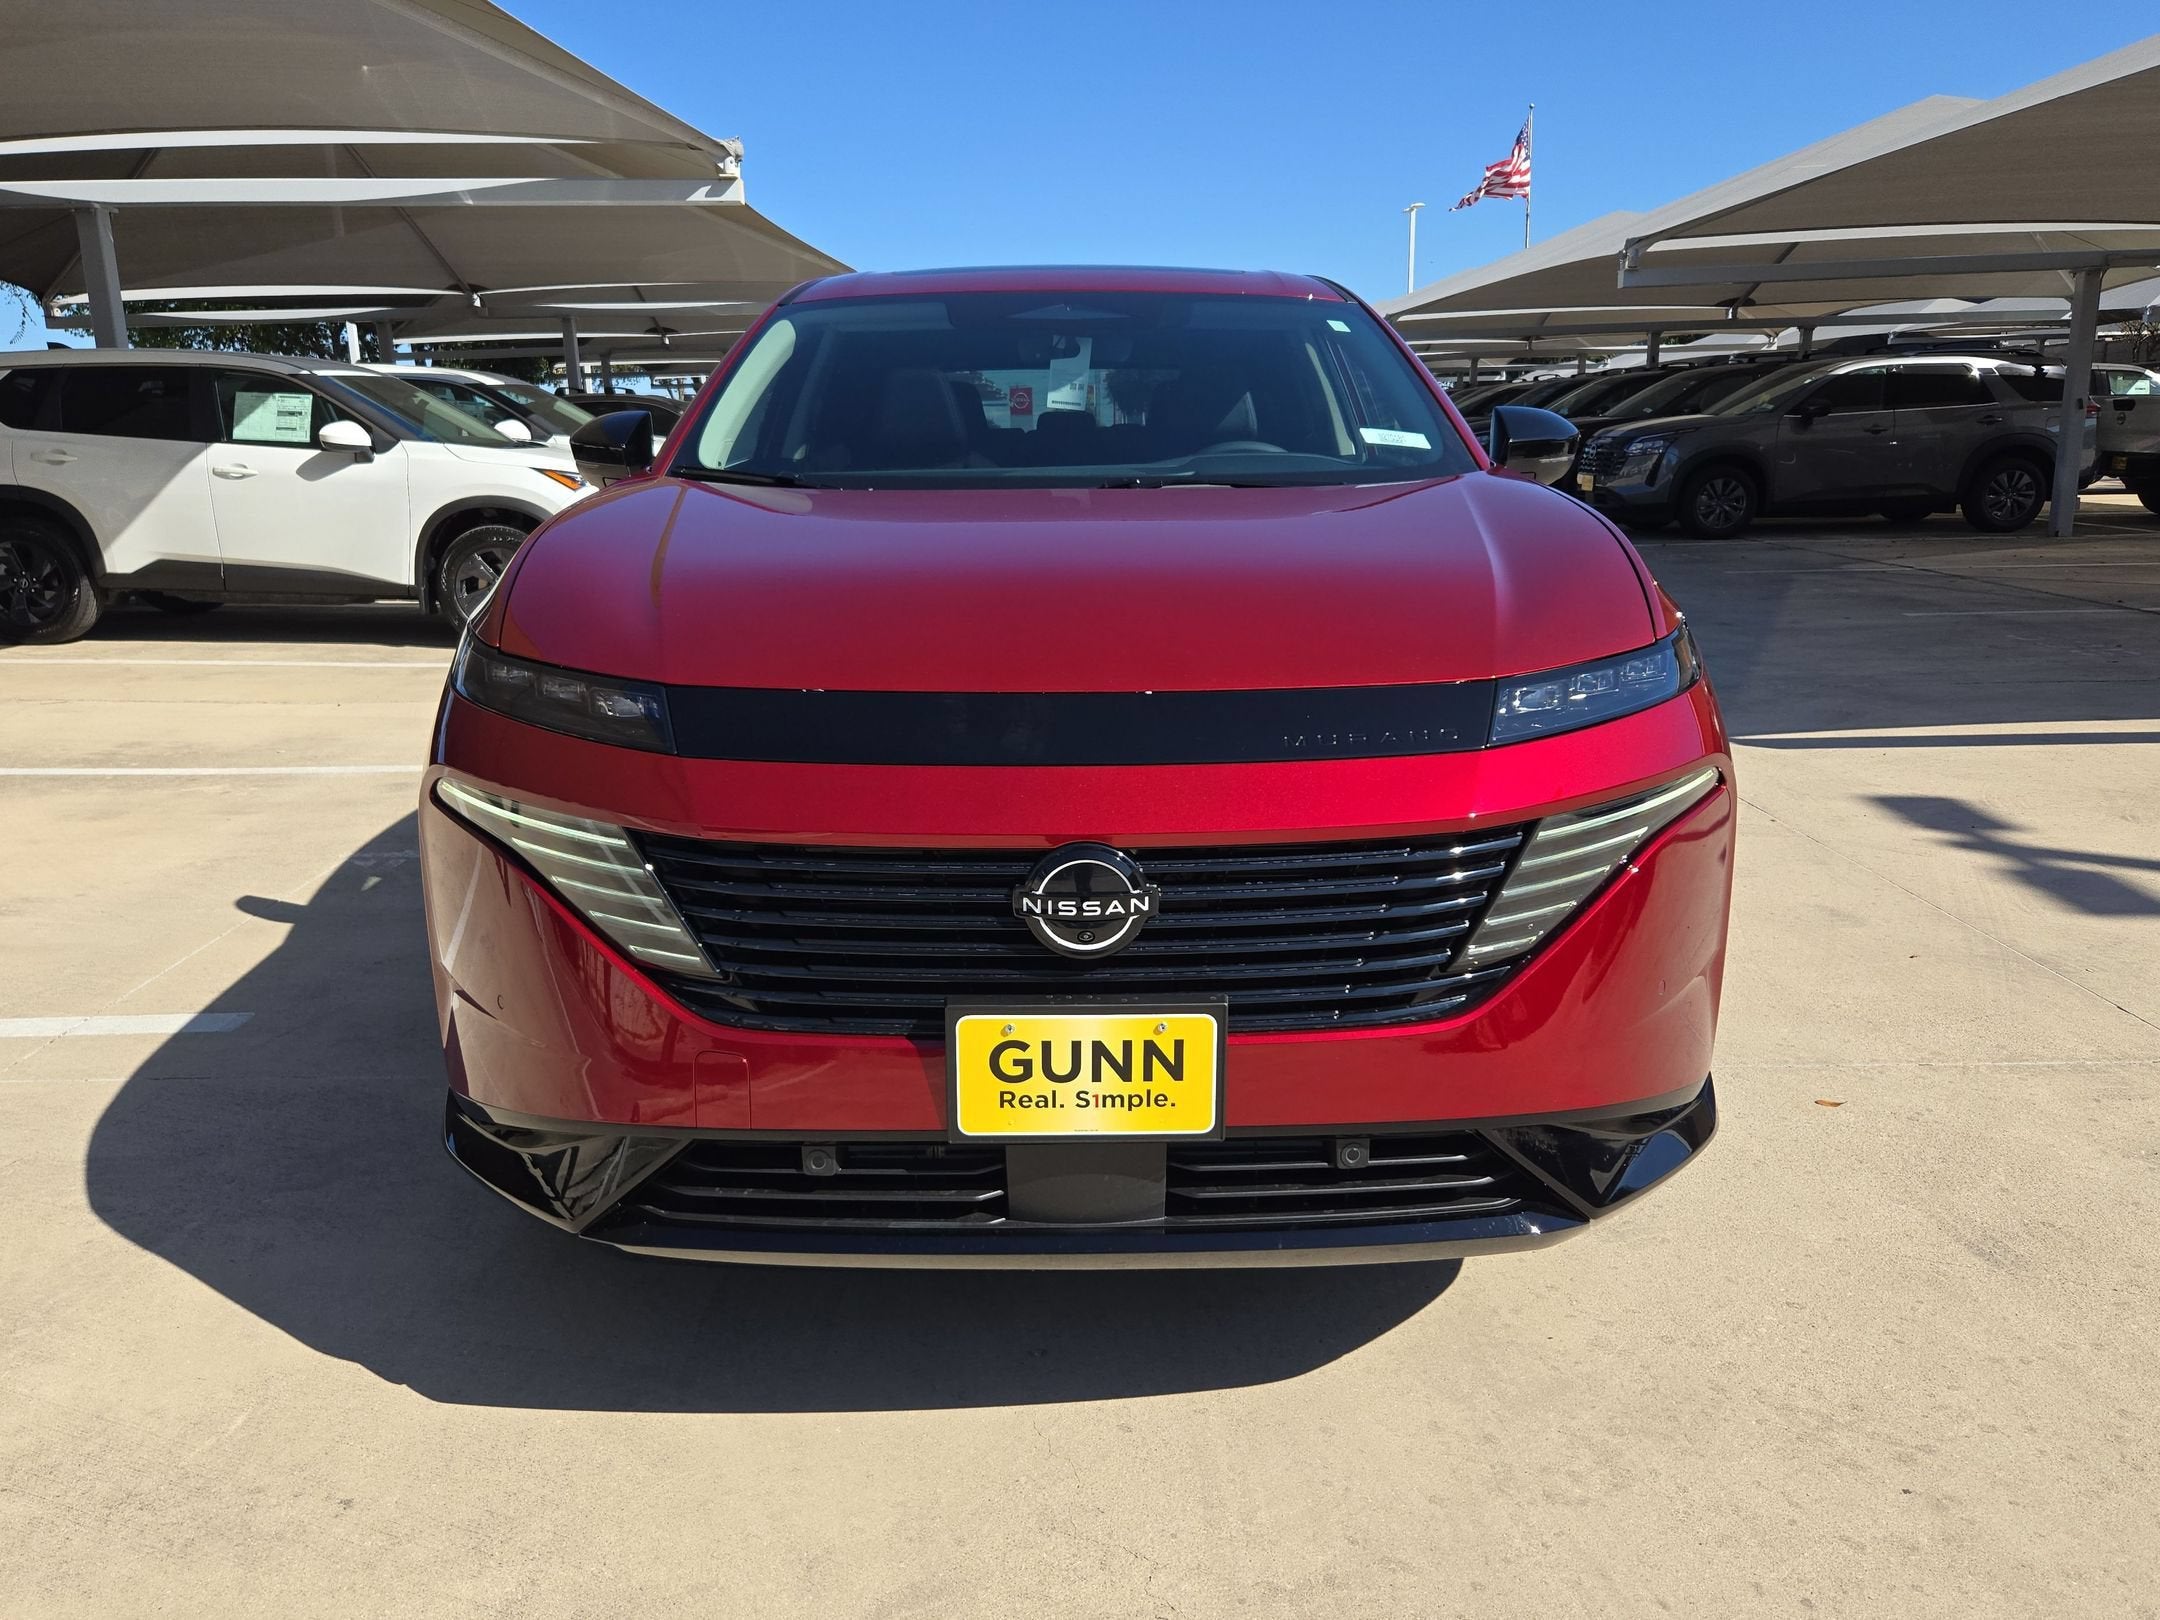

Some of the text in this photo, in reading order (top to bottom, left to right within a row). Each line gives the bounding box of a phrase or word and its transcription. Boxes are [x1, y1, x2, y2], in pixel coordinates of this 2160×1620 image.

[1022, 896, 1150, 916] NISSAN
[989, 1039, 1185, 1083] GUNN
[999, 1090, 1065, 1109] Real.
